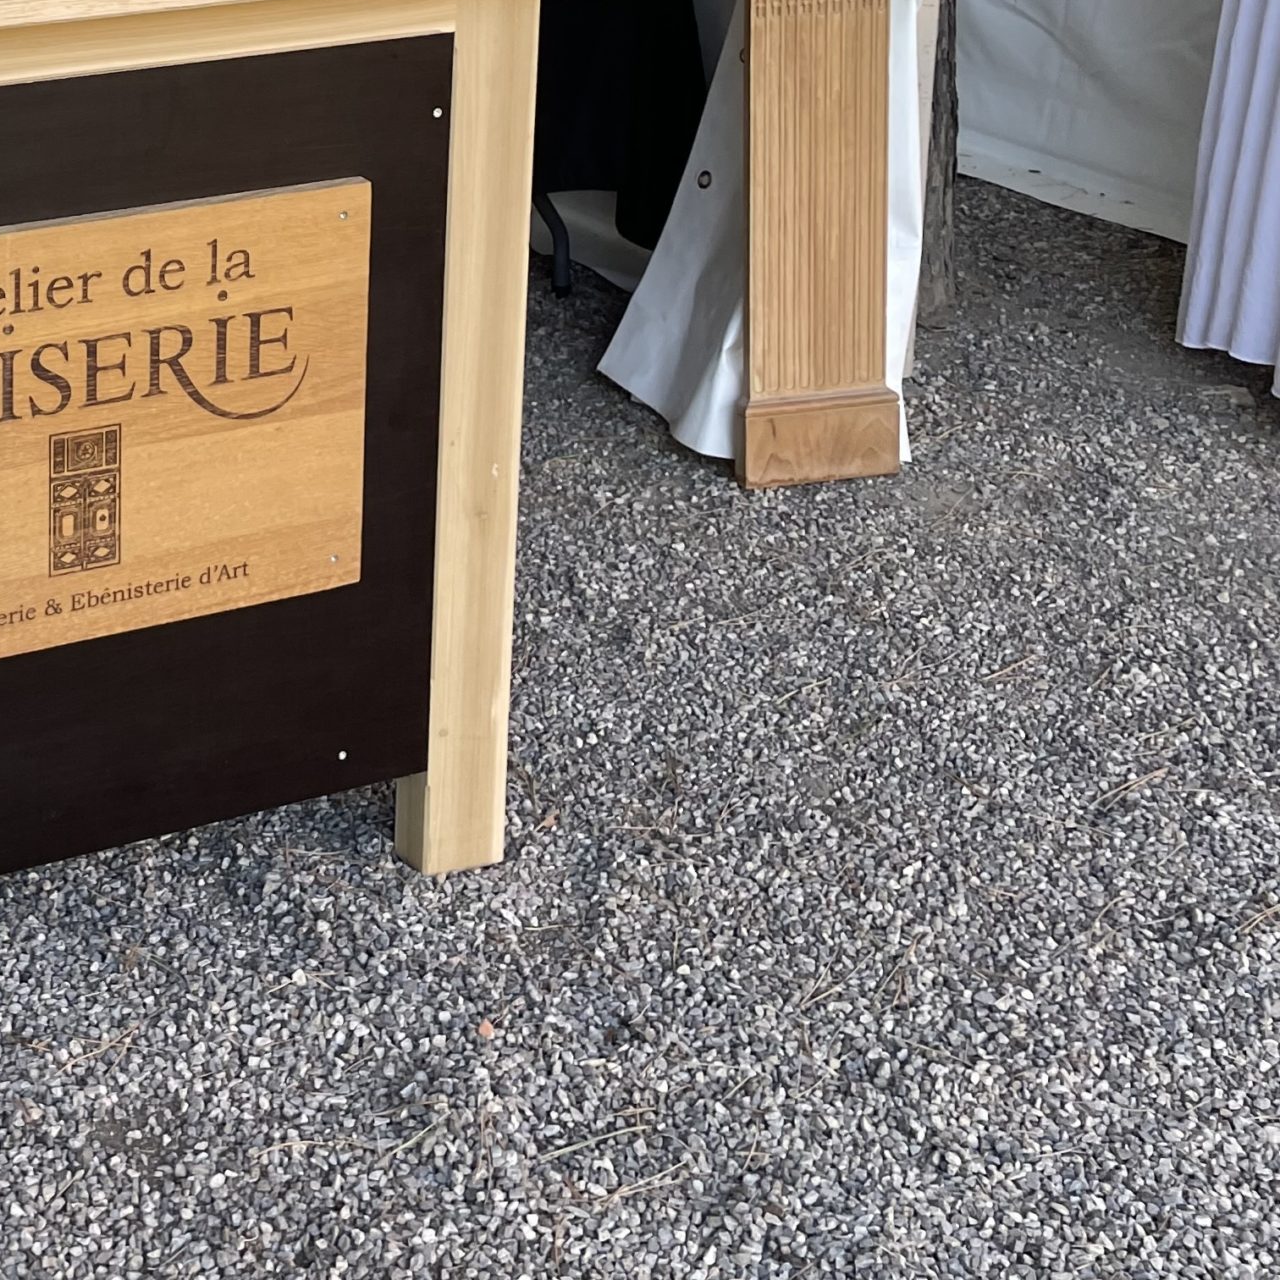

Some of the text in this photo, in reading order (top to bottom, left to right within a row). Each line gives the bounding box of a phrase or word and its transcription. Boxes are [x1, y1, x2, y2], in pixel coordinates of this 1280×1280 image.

[122, 248, 185, 297] de
[206, 238, 255, 286] la
[45, 598, 63, 616] &
[199, 561, 249, 585] d'Art
